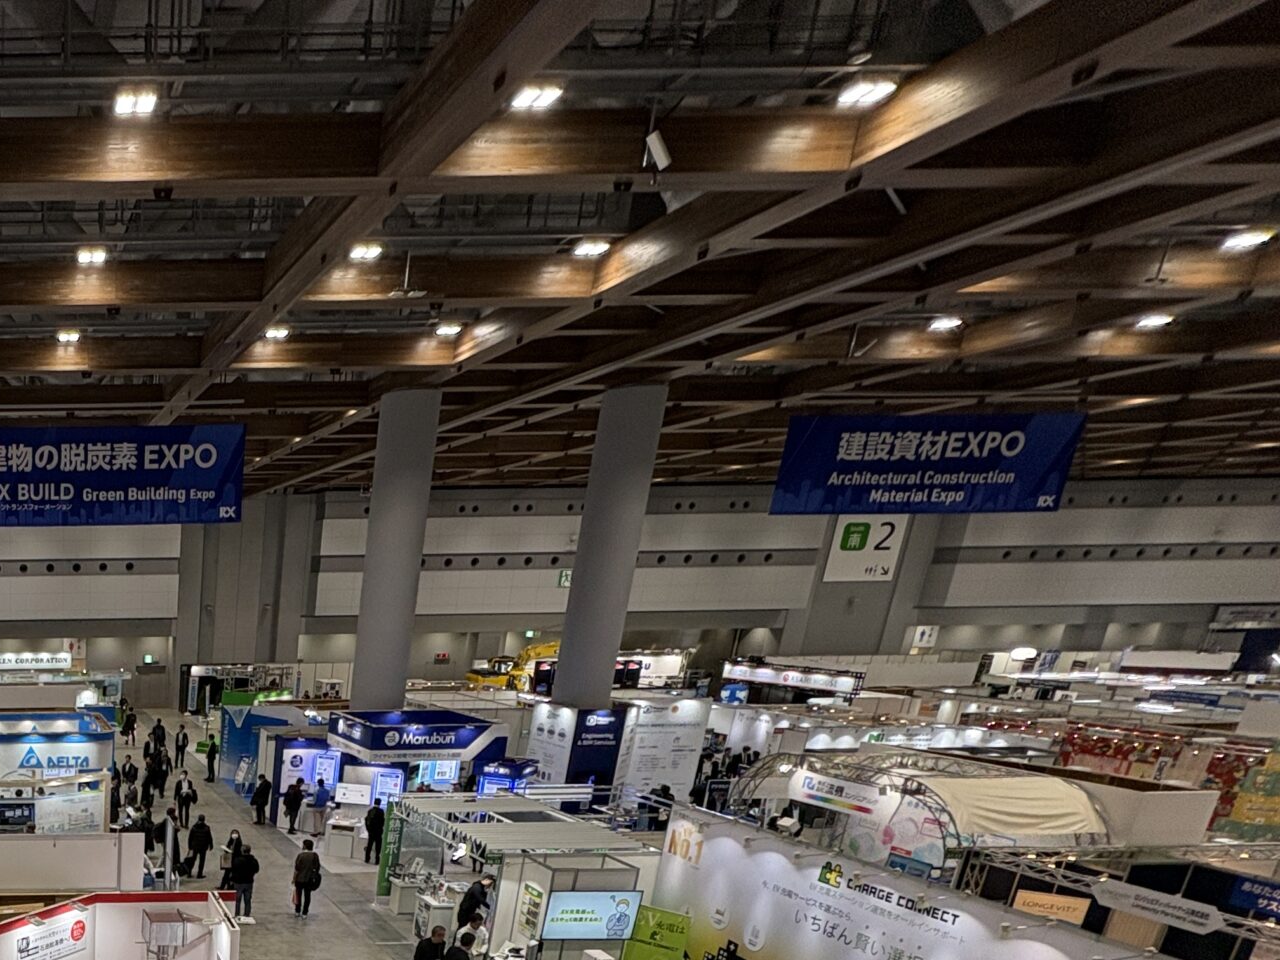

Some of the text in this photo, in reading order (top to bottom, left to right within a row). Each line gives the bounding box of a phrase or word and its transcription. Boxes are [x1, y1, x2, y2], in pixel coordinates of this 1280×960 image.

[144, 443, 218, 470] EXPO
[827, 470, 1015, 486] Architectural Construction
[18, 483, 75, 501] BUILD
[82, 487, 125, 502] Green
[128, 487, 185, 503] Building
[190, 488, 216, 501] Expo
[869, 487, 965, 506] Material Expo
[846, 521, 896, 550] 南 2
[400, 731, 456, 745] Marubun
[1021, 899, 1080, 913] LONGEVITY
